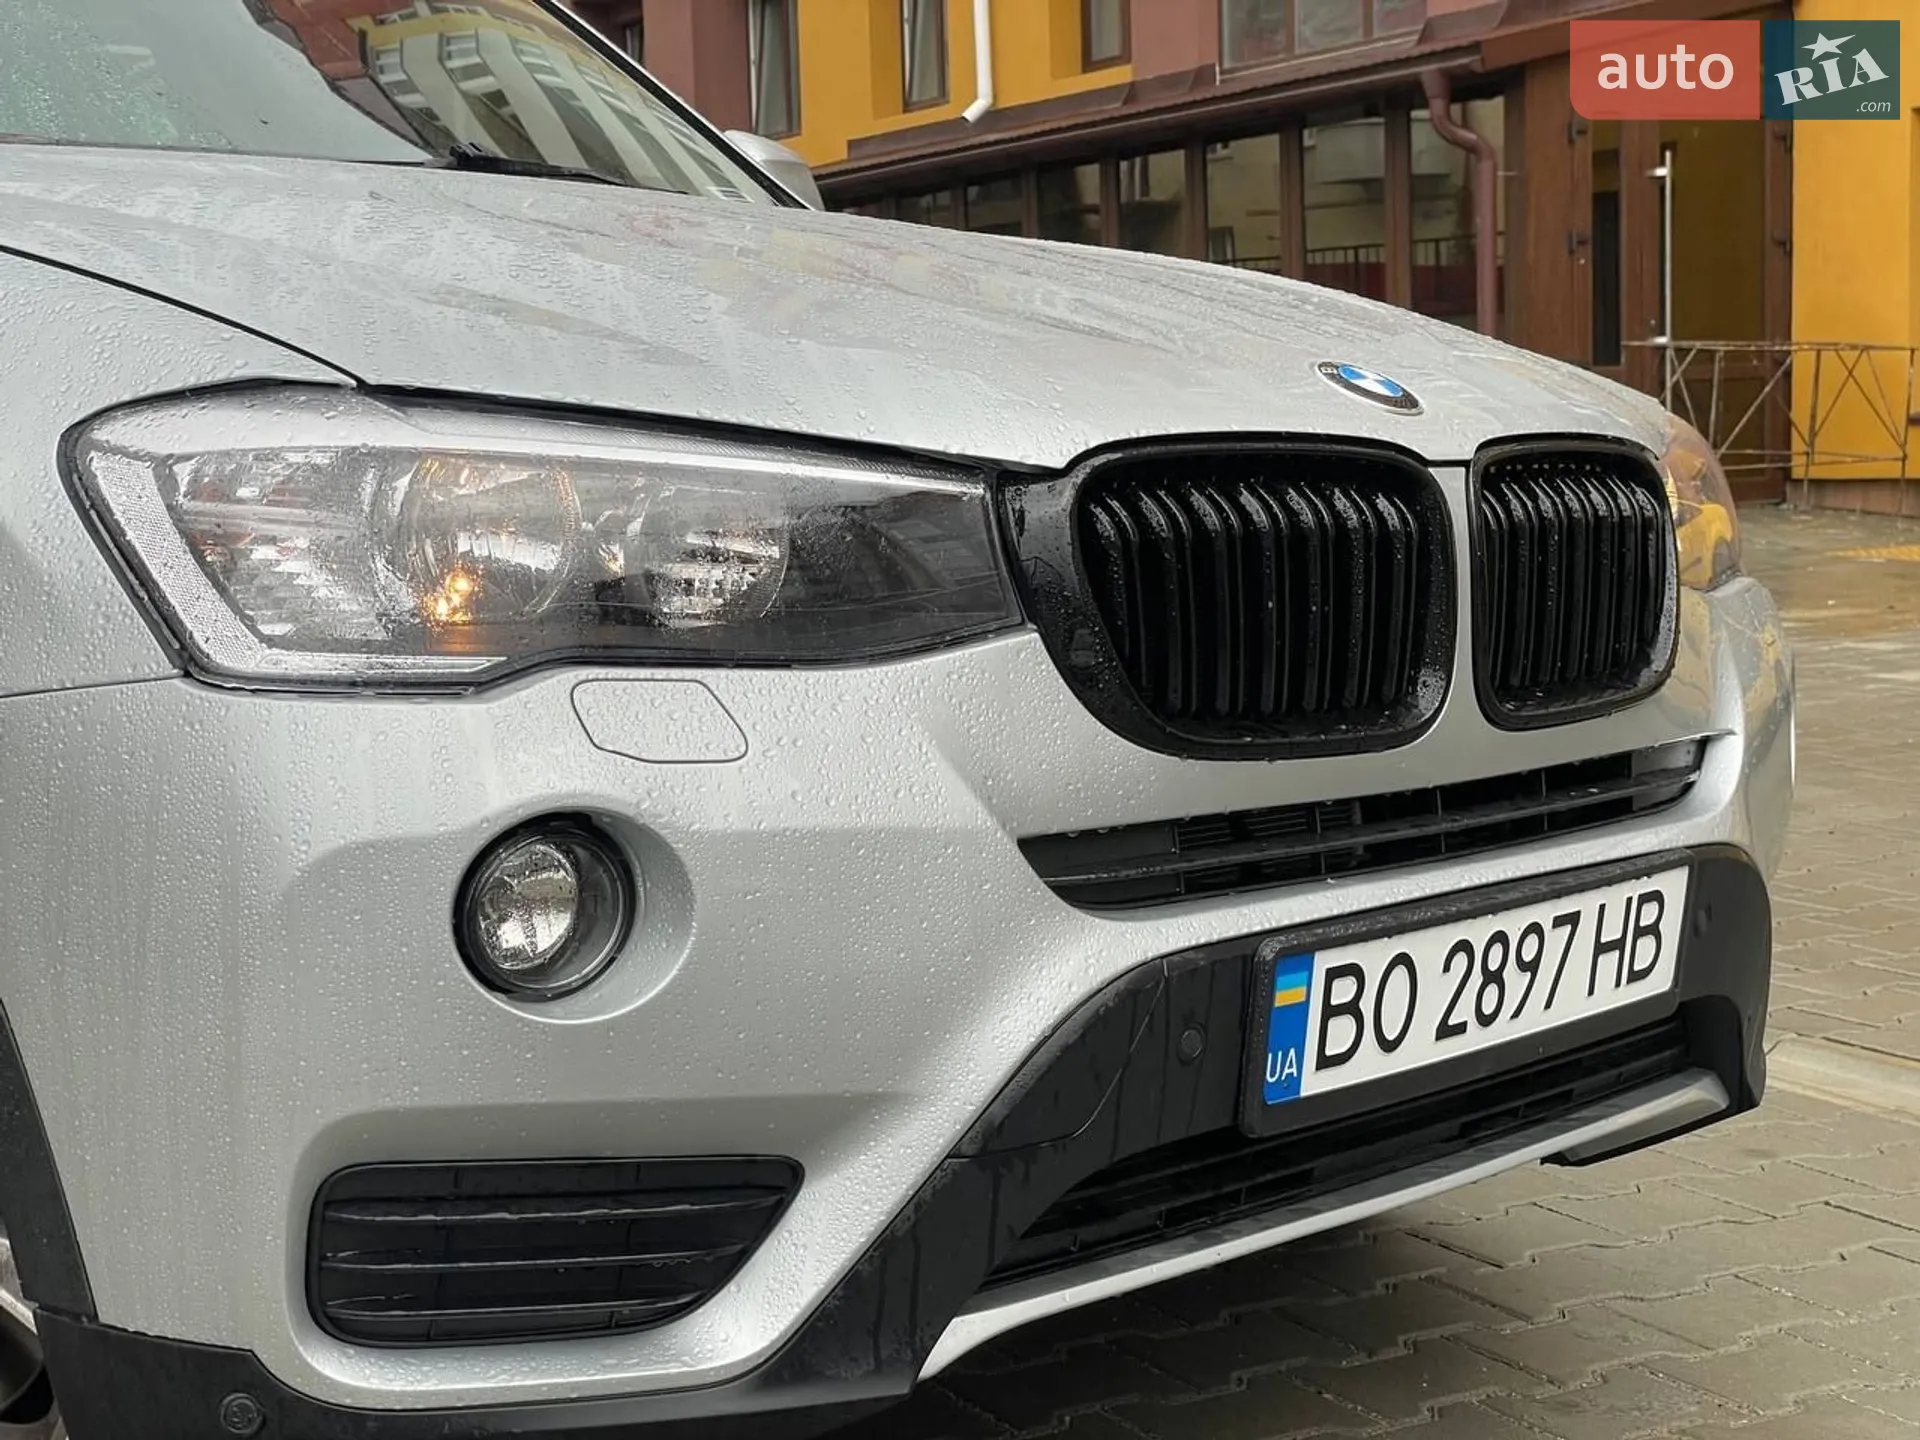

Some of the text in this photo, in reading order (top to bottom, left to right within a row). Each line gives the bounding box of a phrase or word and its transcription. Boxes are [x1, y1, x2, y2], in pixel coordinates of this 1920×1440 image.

[1315, 889, 1666, 1072] BO 2897 HB
[1265, 1052, 1298, 1083] UA
